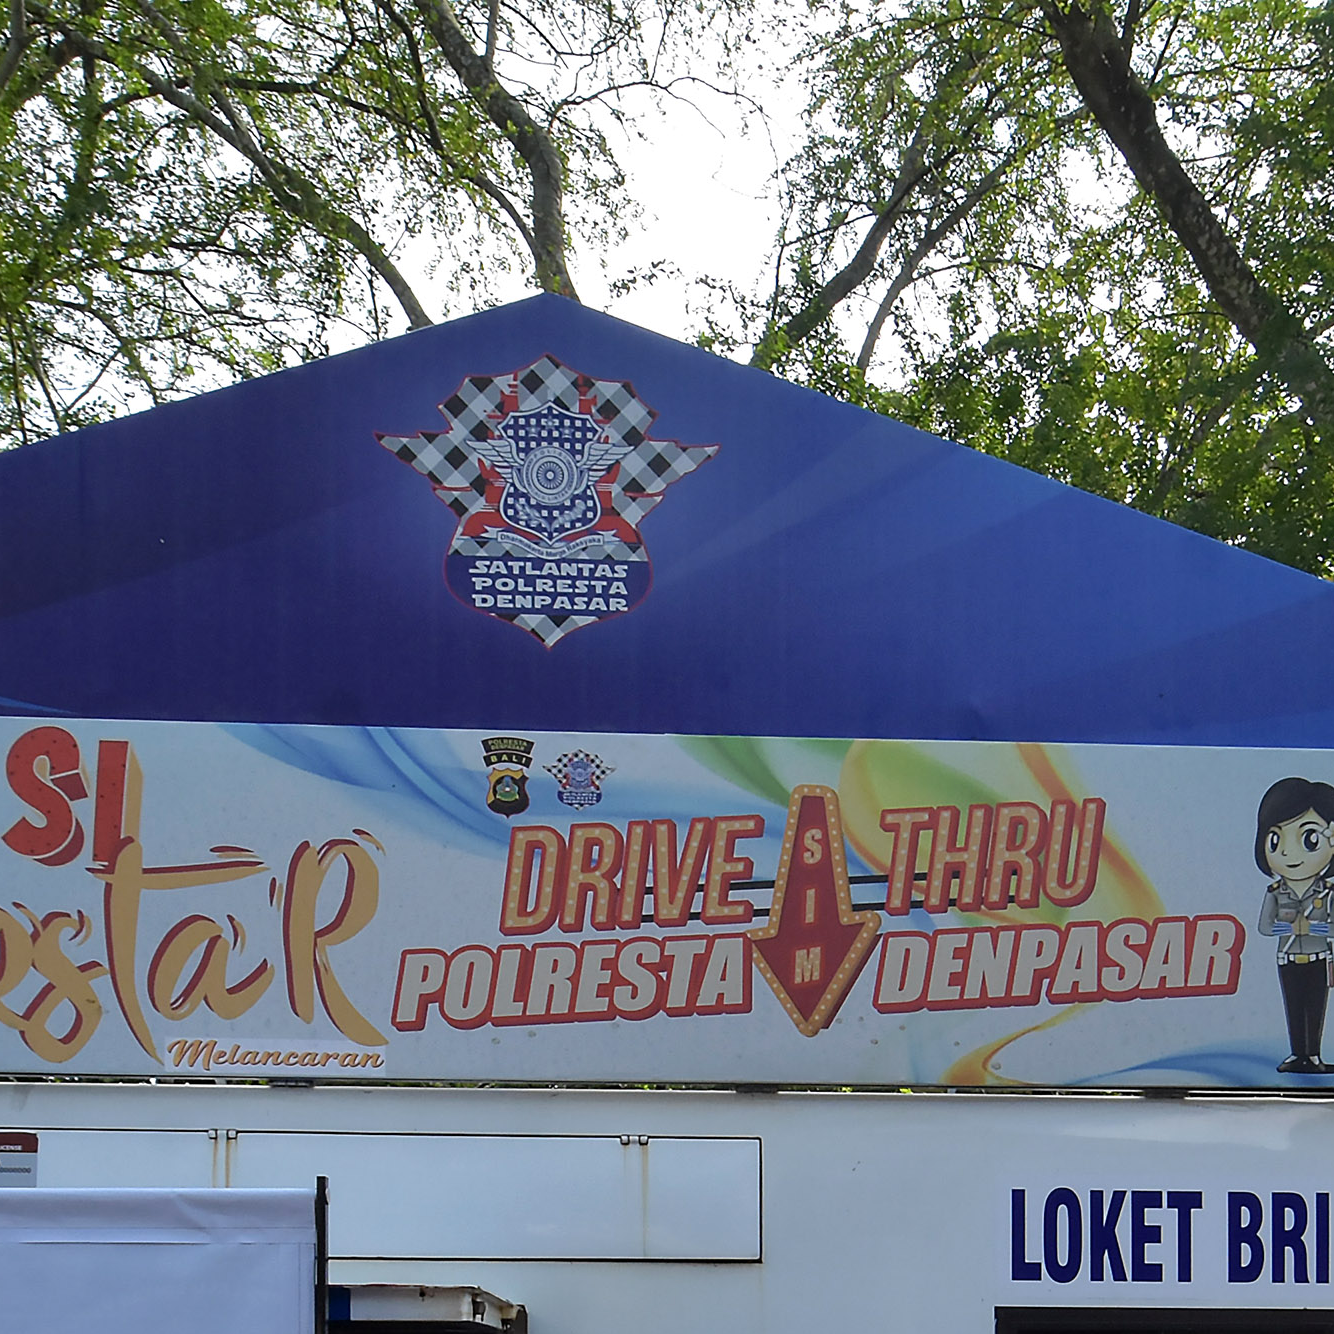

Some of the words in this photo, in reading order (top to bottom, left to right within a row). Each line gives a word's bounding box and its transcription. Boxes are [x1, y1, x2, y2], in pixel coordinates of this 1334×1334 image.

[469, 560, 629, 579] SATLANTAS
[471, 577, 629, 595] POLRESTA
[471, 594, 629, 612] DENPASAR
[490, 755, 527, 764] BALI
[1, 725, 143, 867] SI
[500, 815, 765, 936] DRIVE
[879, 797, 1107, 916] THRU
[792, 827, 824, 987] SIM
[392, 927, 757, 1032] POLRESTA
[873, 912, 1247, 1013] DENPASAR
[167, 1039, 386, 1071] Melancaran
[1010, 1187, 1203, 1284] LOKET
[1227, 1190, 1330, 1285] BRI
